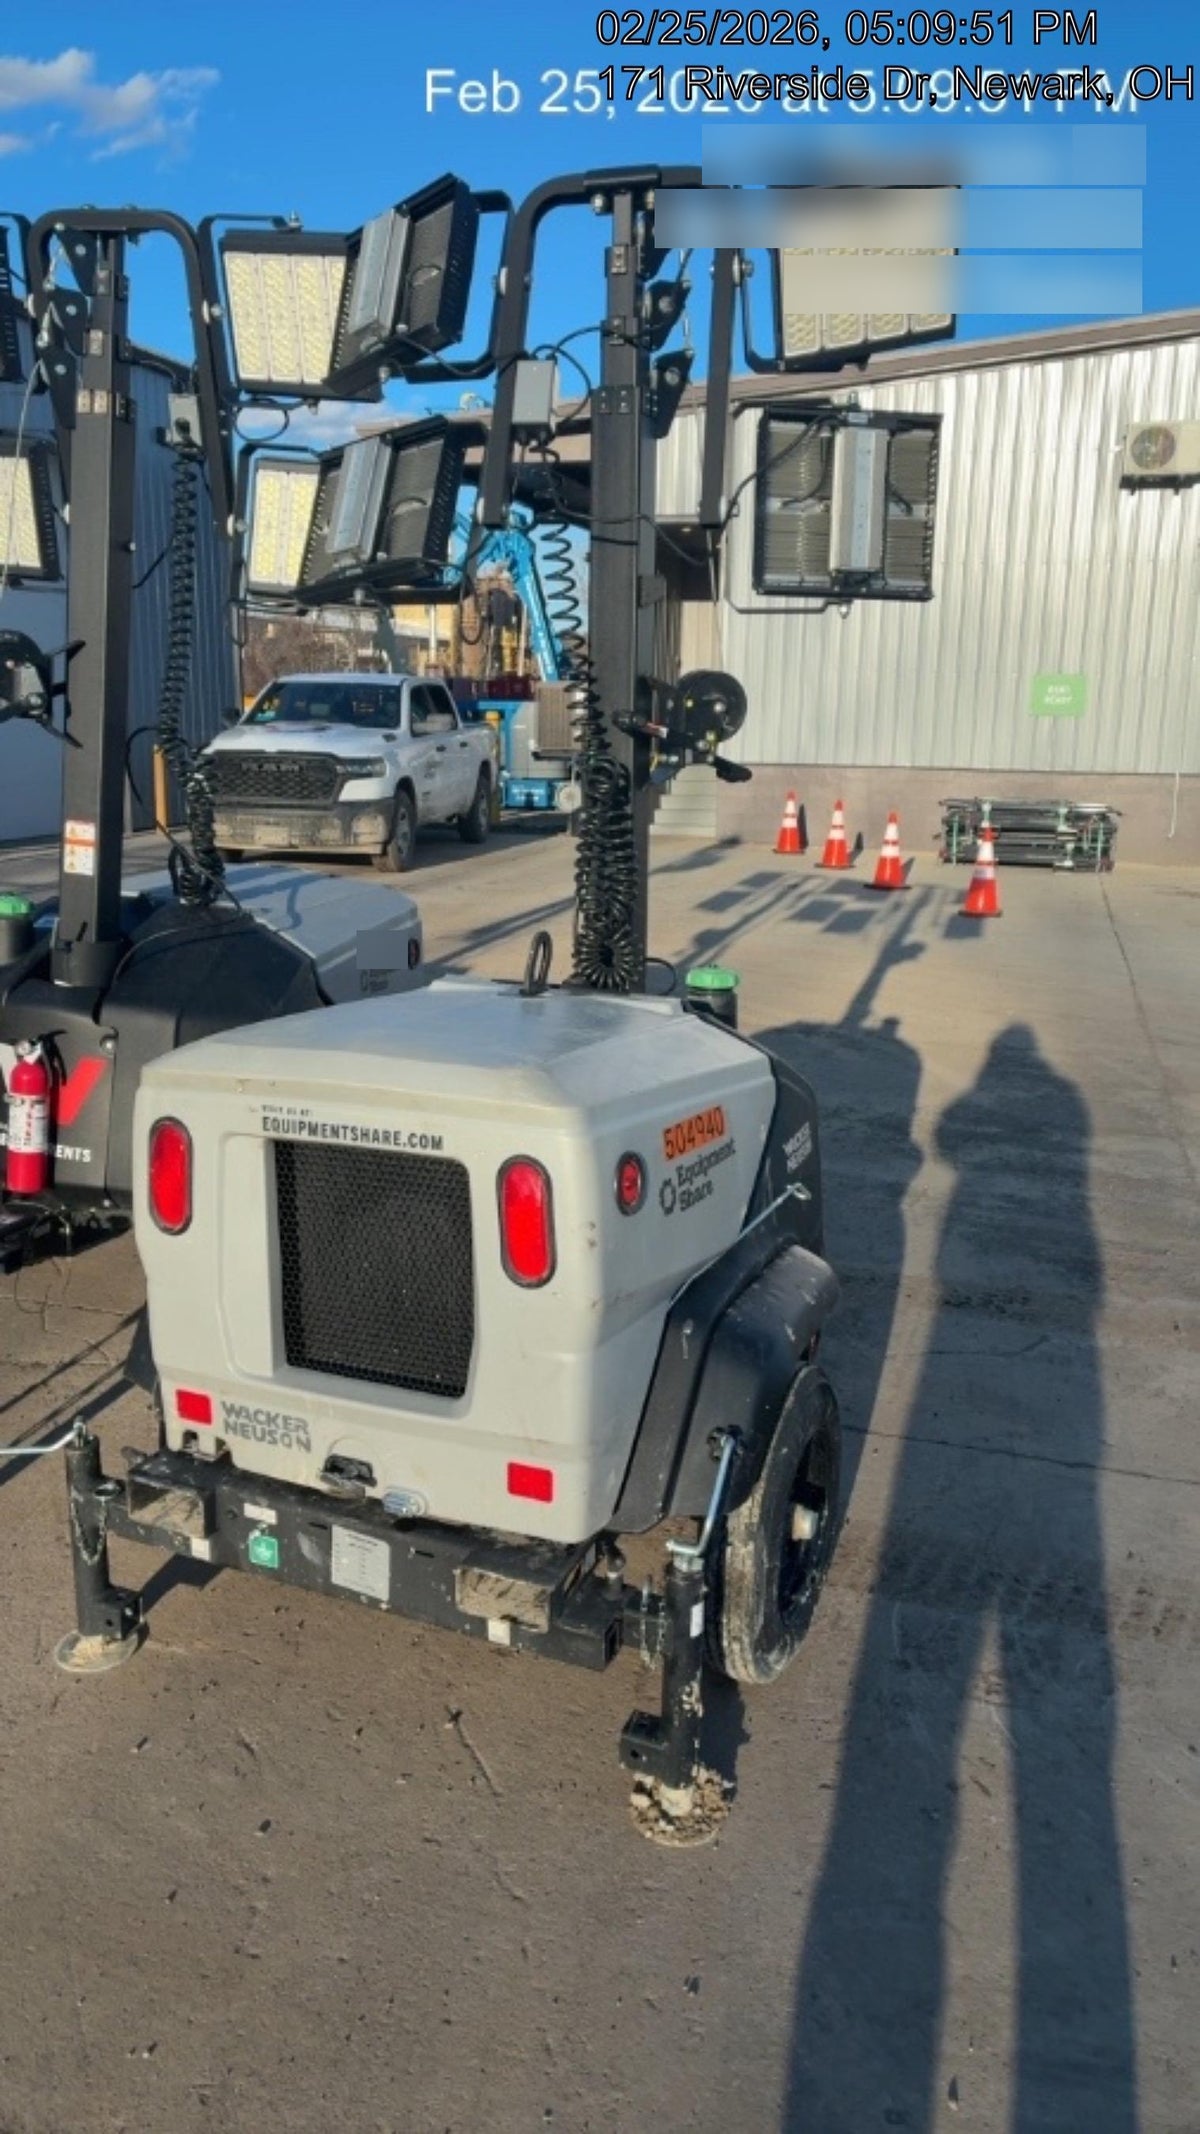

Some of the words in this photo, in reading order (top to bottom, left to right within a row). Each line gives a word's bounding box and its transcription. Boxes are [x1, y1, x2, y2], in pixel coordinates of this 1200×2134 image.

[262, 1116, 444, 1150] EQUIPMENTSHARE.COM
[664, 1106, 724, 1160] 504940
[676, 1137, 736, 1187] Equipment
[221, 1401, 309, 1435] WACKER
[223, 1418, 312, 1453] NEUSON
